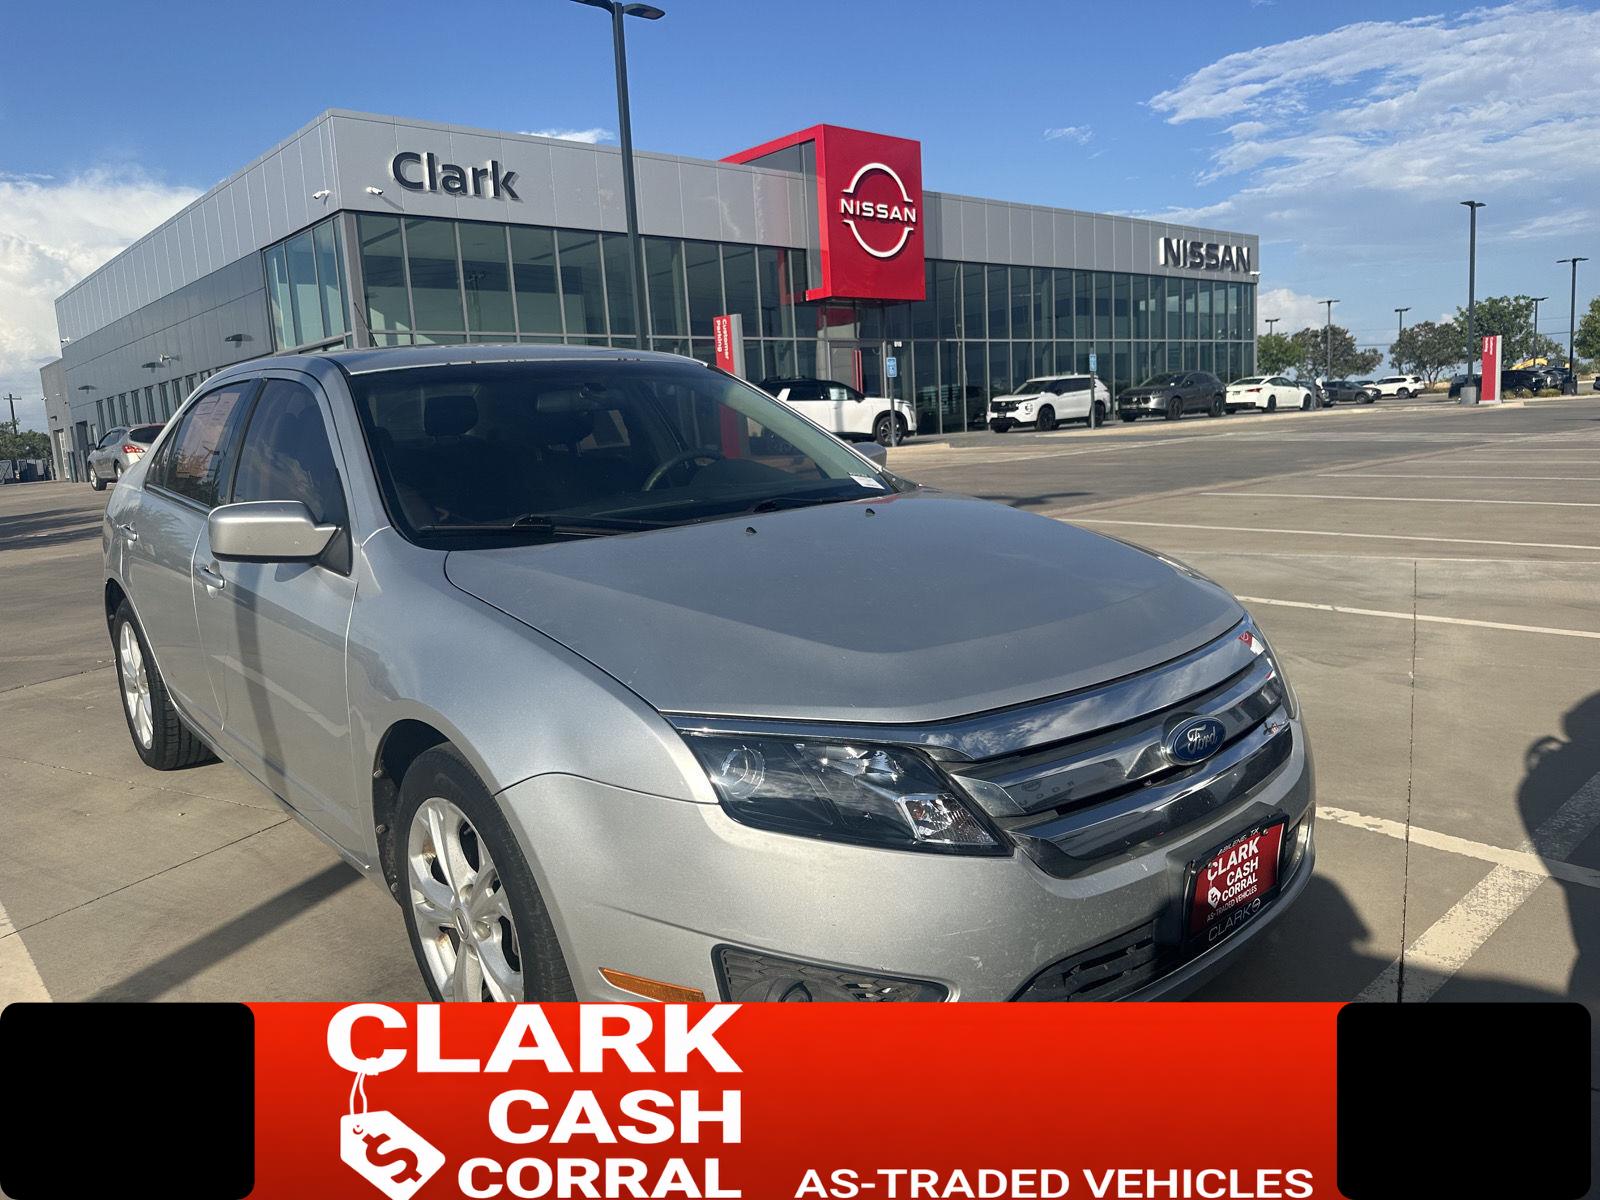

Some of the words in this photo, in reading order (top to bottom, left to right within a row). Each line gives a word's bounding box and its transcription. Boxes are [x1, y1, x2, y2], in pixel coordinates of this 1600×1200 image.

[389, 151, 520, 201] Clark
[840, 198, 917, 223] NISSAN
[1159, 237, 1251, 273] NISSAN
[722, 318, 730, 360] Customer
[1185, 724, 1217, 754] Ford
[1207, 836, 1260, 881] CLARK
[1226, 856, 1259, 886] CASH
[1222, 872, 1258, 901] CORRAL
[1208, 903, 1252, 942] CLARK
